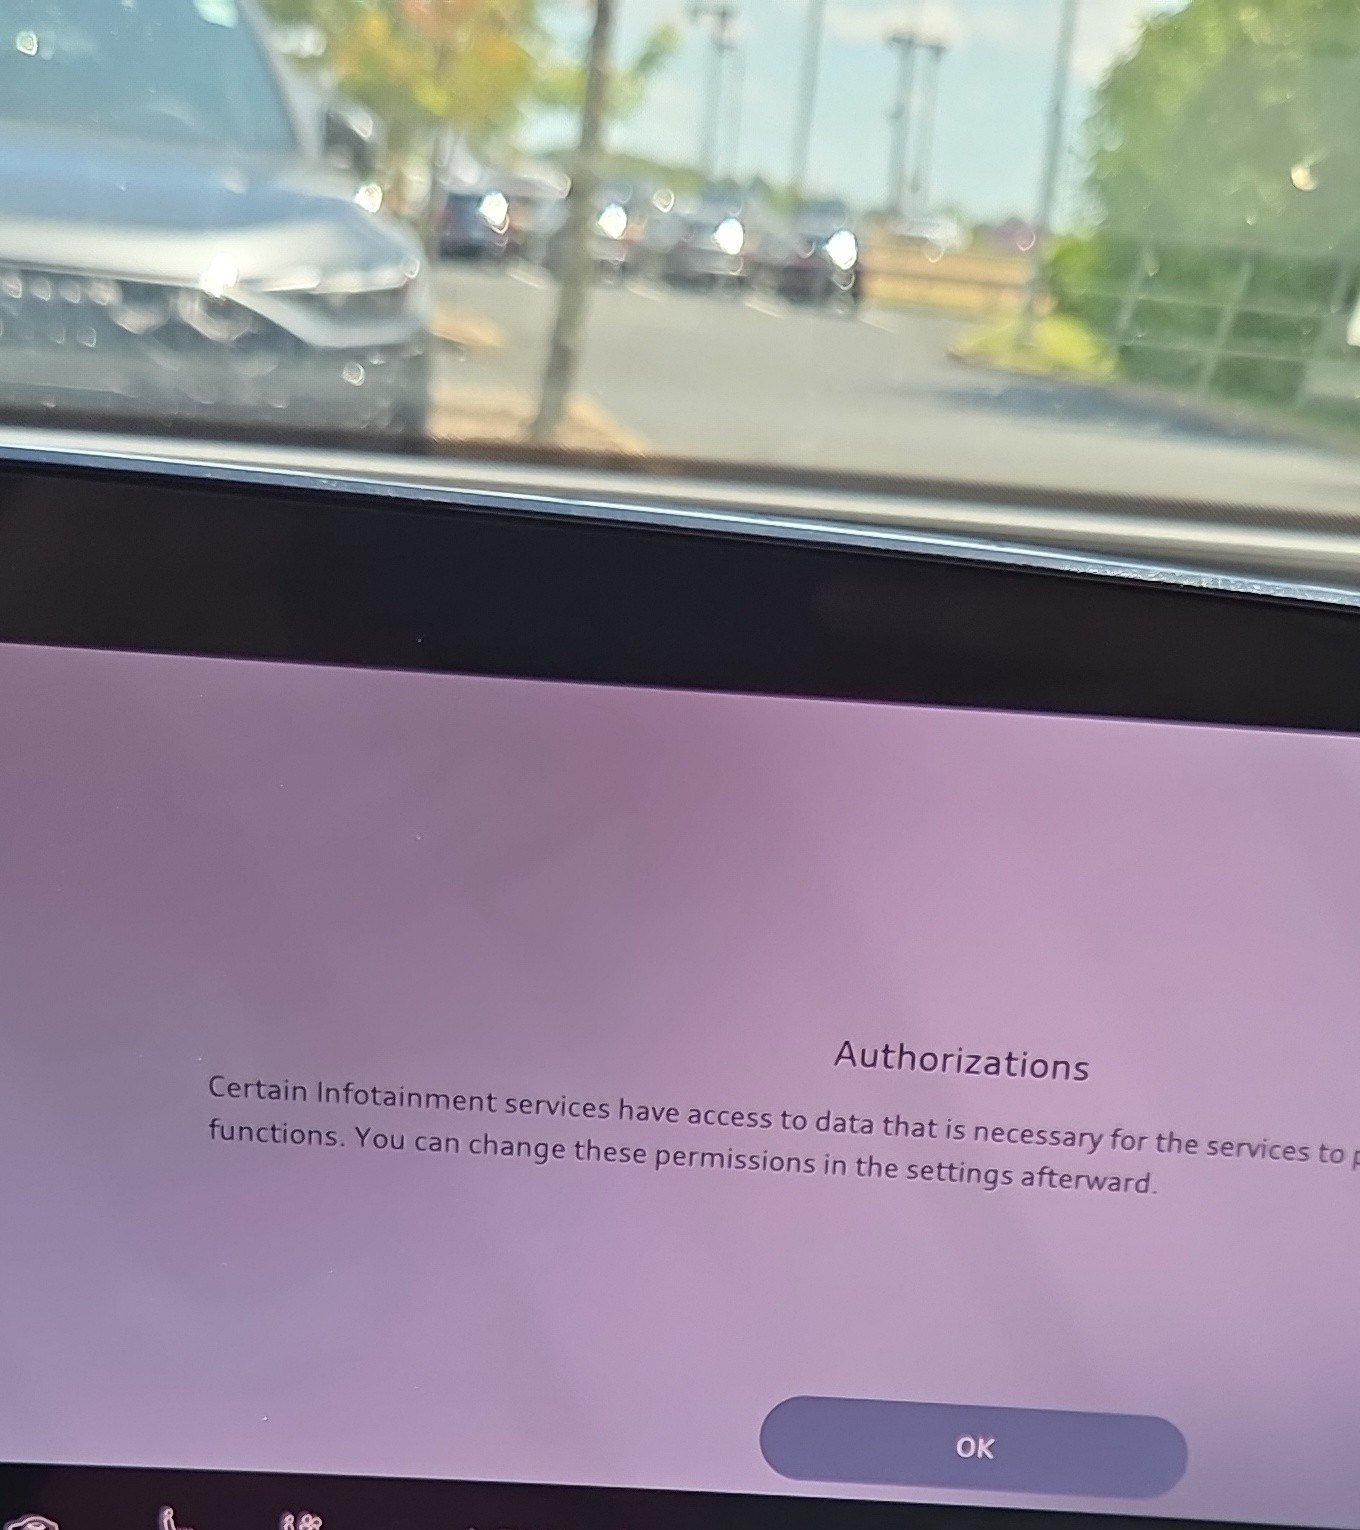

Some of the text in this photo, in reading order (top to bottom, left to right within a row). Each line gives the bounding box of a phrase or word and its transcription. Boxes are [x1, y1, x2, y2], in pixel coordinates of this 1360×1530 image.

[833, 1041, 1089, 1081] Authorizations
[209, 1074, 307, 1102] Certain
[318, 1081, 498, 1113] Infotainment
[505, 1095, 610, 1119] services
[619, 1097, 679, 1123] have
[687, 1109, 772, 1129] access
[779, 1110, 807, 1130] to
[816, 1109, 873, 1135] data
[883, 1114, 939, 1138] that
[946, 1118, 966, 1140] is
[974, 1126, 1104, 1155] necessary
[1109, 1128, 1150, 1151] for
[1155, 1130, 1200, 1154] the
[1205, 1138, 1313, 1162] services
[1318, 1142, 1346, 1164] to
[208, 1117, 1157, 1194] functions. You can change these permissions in the settings afterward.
[956, 1434, 996, 1460] OK
